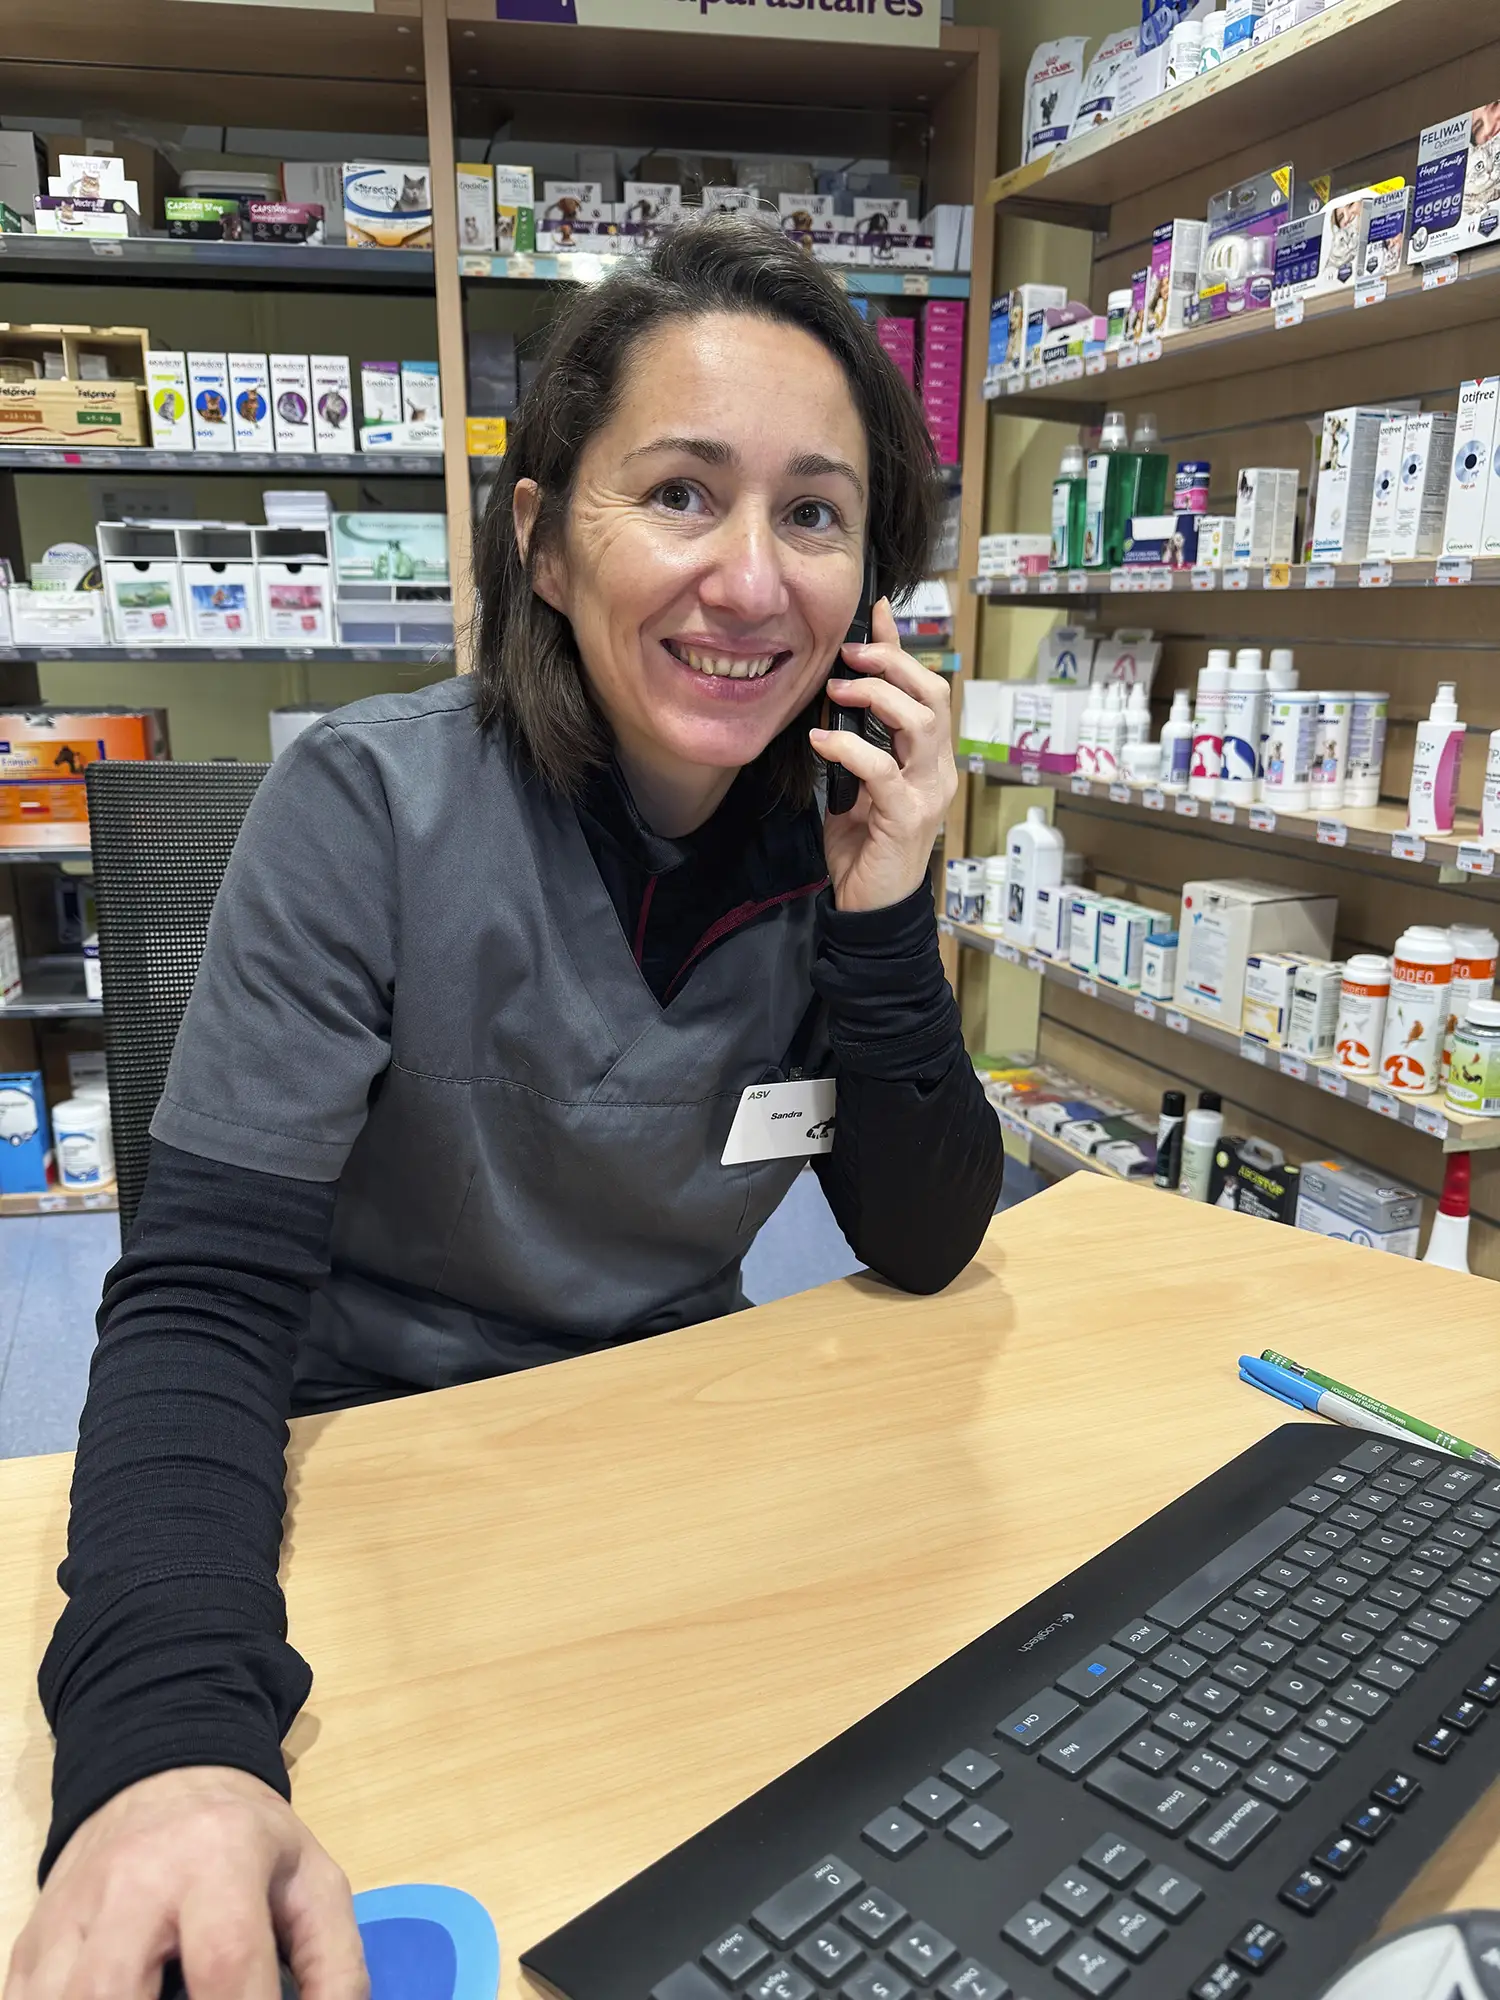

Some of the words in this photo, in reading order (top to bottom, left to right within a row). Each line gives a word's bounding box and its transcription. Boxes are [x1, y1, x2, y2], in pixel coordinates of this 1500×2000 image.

[1422, 119, 1468, 146] FELIWAY
[1434, 133, 1466, 150] Optimum
[1374, 190, 1404, 206] FELIWAY
[1280, 221, 1306, 236] FELIWAY
[747, 1090, 771, 1101] ASV
[771, 1110, 803, 1120] Sandra
[1368, 1494, 1382, 1504] W
[1348, 1512, 1360, 1520] X
[1472, 1510, 1484, 1518] A
[1402, 1518, 1414, 1526] S
[1326, 1530, 1338, 1538] C
[1452, 1528, 1466, 1538] Z
[1380, 1536, 1394, 1544] D
[1432, 1548, 1444, 1556] E
[1360, 1556, 1372, 1564] F
[1280, 1568, 1292, 1576] B
[1410, 1568, 1424, 1576] R
[1336, 1576, 1348, 1584] G
[1254, 1588, 1268, 1598] N
[1390, 1590, 1402, 1598] T
[1312, 1596, 1326, 1606] H
[1366, 1610, 1380, 1620] Y
[1288, 1618, 1300, 1628] J
[1018, 1622, 1062, 1652] Logitech
[1342, 1632, 1356, 1642] U
[1260, 1640, 1274, 1650] K
[1316, 1656, 1328, 1664] I
[1234, 1664, 1248, 1672] L
[1390, 1664, 1404, 1674] 8
[1290, 1680, 1304, 1690] O
[1204, 1688, 1220, 1700] M
[1264, 1706, 1276, 1716] P
[1022, 1714, 1040, 1728] Ctrl
[1182, 1718, 1198, 1728] %
[1058, 1742, 1080, 1758] Maj
[1158, 1788, 1186, 1812] Entrée
[1232, 1798, 1260, 1823] Retour
[814, 1864, 834, 1880] Inser
[826, 1874, 840, 1886] 0
[858, 1898, 876, 1912] Fin
[870, 1906, 886, 1918] 1
[716, 1932, 744, 1954] Suppr
[824, 1944, 842, 1958] 2
[918, 1944, 934, 1958] 4
[764, 1970, 790, 1988] Page
[774, 1984, 794, 2000] 3
[872, 1982, 890, 1998] 5
[970, 1982, 988, 1998] 7
